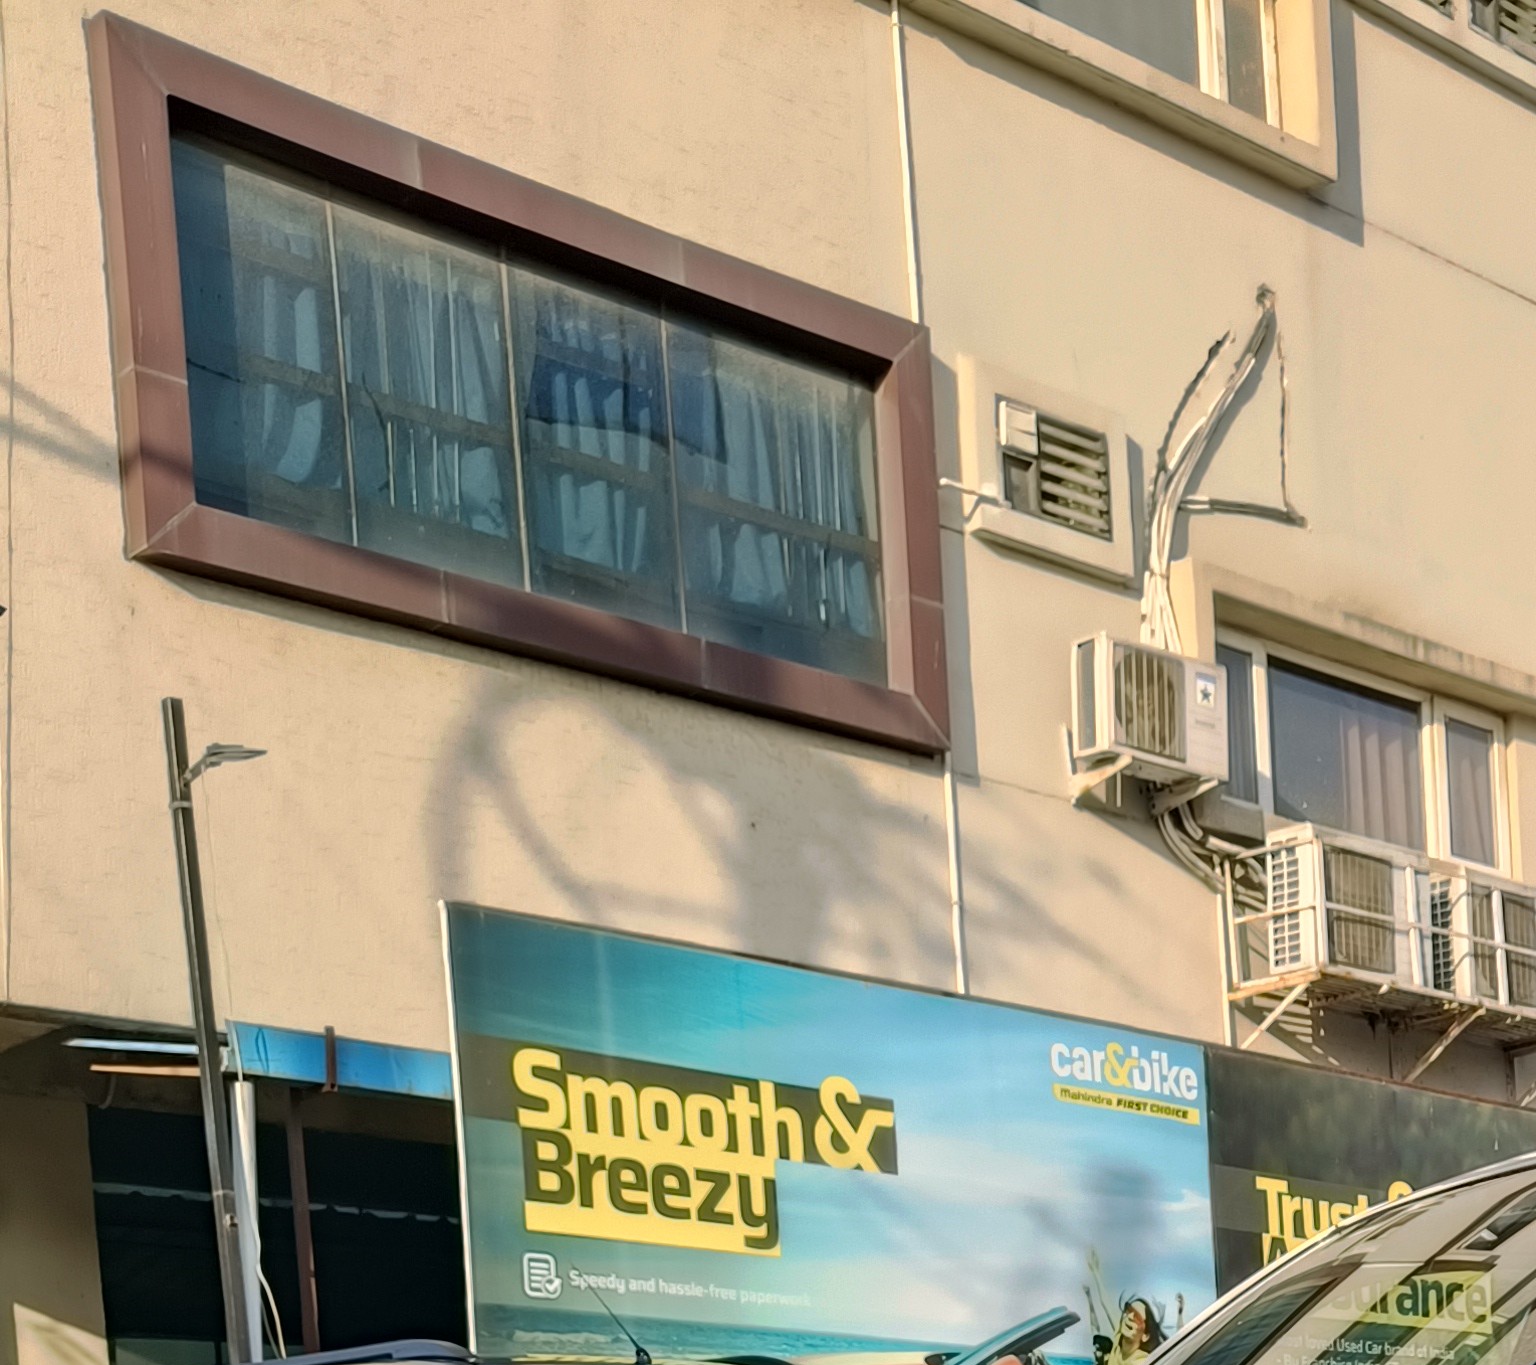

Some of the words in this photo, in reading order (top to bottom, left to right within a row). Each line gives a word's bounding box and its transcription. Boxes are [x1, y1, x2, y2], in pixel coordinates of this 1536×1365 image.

[1050, 1041, 1199, 1101] car&bike
[512, 1047, 806, 1164] Smooth
[813, 1075, 894, 1174] &
[1059, 1087, 1113, 1107] Mahindra
[1116, 1097, 1149, 1112] FIRST
[1149, 1102, 1189, 1119] CHOICE
[522, 1127, 780, 1250] Breezy
[568, 1269, 626, 1294] Speedy
[628, 1276, 657, 1293] and
[1336, 1338, 1363, 1354] Used
[1364, 1341, 1382, 1355] Car
